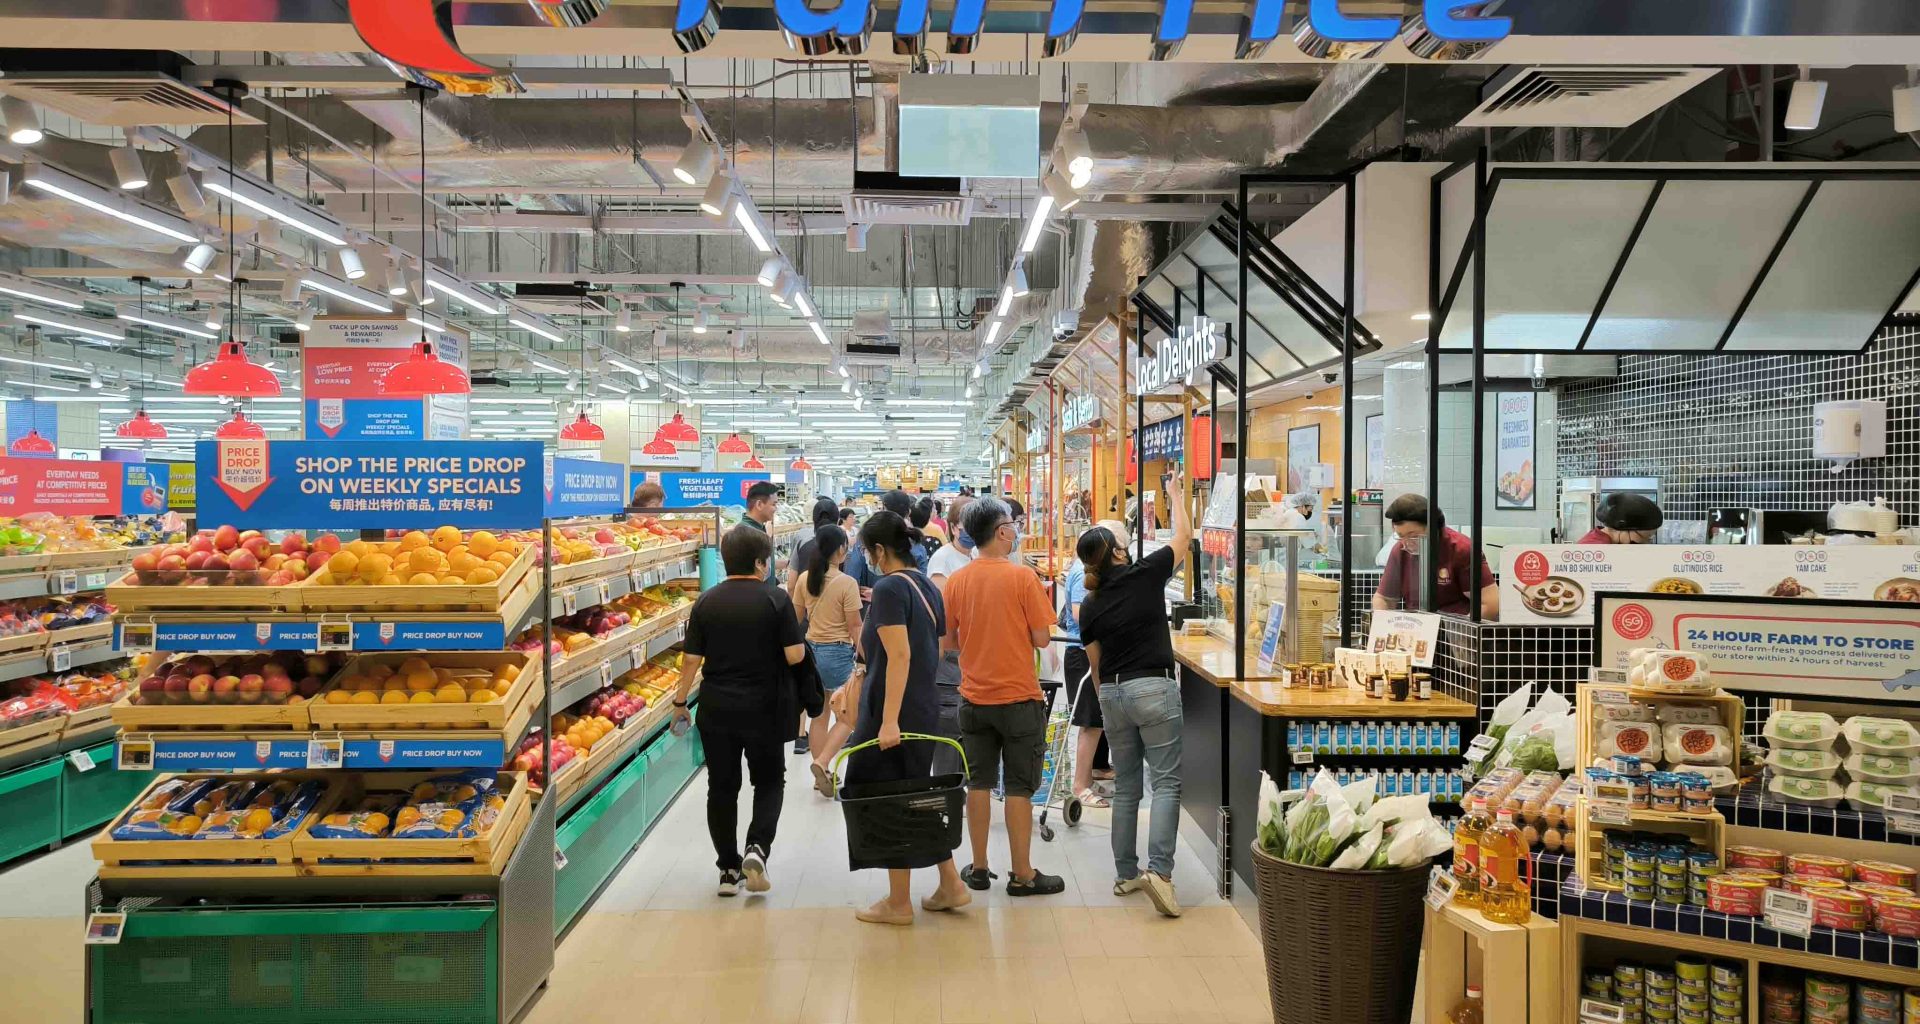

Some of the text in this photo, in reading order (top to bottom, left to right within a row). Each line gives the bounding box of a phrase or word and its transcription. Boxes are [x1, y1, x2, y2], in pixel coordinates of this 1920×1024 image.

[1136, 316, 1216, 396] Local Delights
[1504, 420, 1528, 433] FRESHNESS
[228, 448, 260, 456] PRICE
[228, 458, 260, 467] DROP
[295, 457, 352, 474] SHOP
[358, 458, 398, 473] THE
[404, 457, 461, 473] PRICE
[469, 457, 526, 473] DROP
[46, 470, 99, 479] EVERYDAY NEEDS
[36, 480, 44, 488] AT
[46, 481, 86, 489] COMPETITIVE
[300, 478, 521, 494] ON WEEKLY SPECIALS
[565, 473, 617, 489] PRICE DROP BUY NOW
[1554, 564, 1612, 572] JIAN BO SHUI KUEH
[1673, 564, 1723, 572] GLUTINOUS RICE
[1796, 564, 1827, 572] YAM CAKE
[1903, 564, 1918, 572] CHEE
[1625, 616, 1640, 627] SG
[1688, 630, 1914, 650] 24 HOUR FARM TO STORE
[1692, 643, 1742, 651] Experience
[1745, 645, 1795, 653] farm-fresh
[1799, 648, 1846, 656] goodness
[1849, 650, 1895, 659] delivered
[1757, 654, 1785, 662] within
[1803, 657, 1830, 665] hours
[1846, 659, 1885, 667] harvest.
